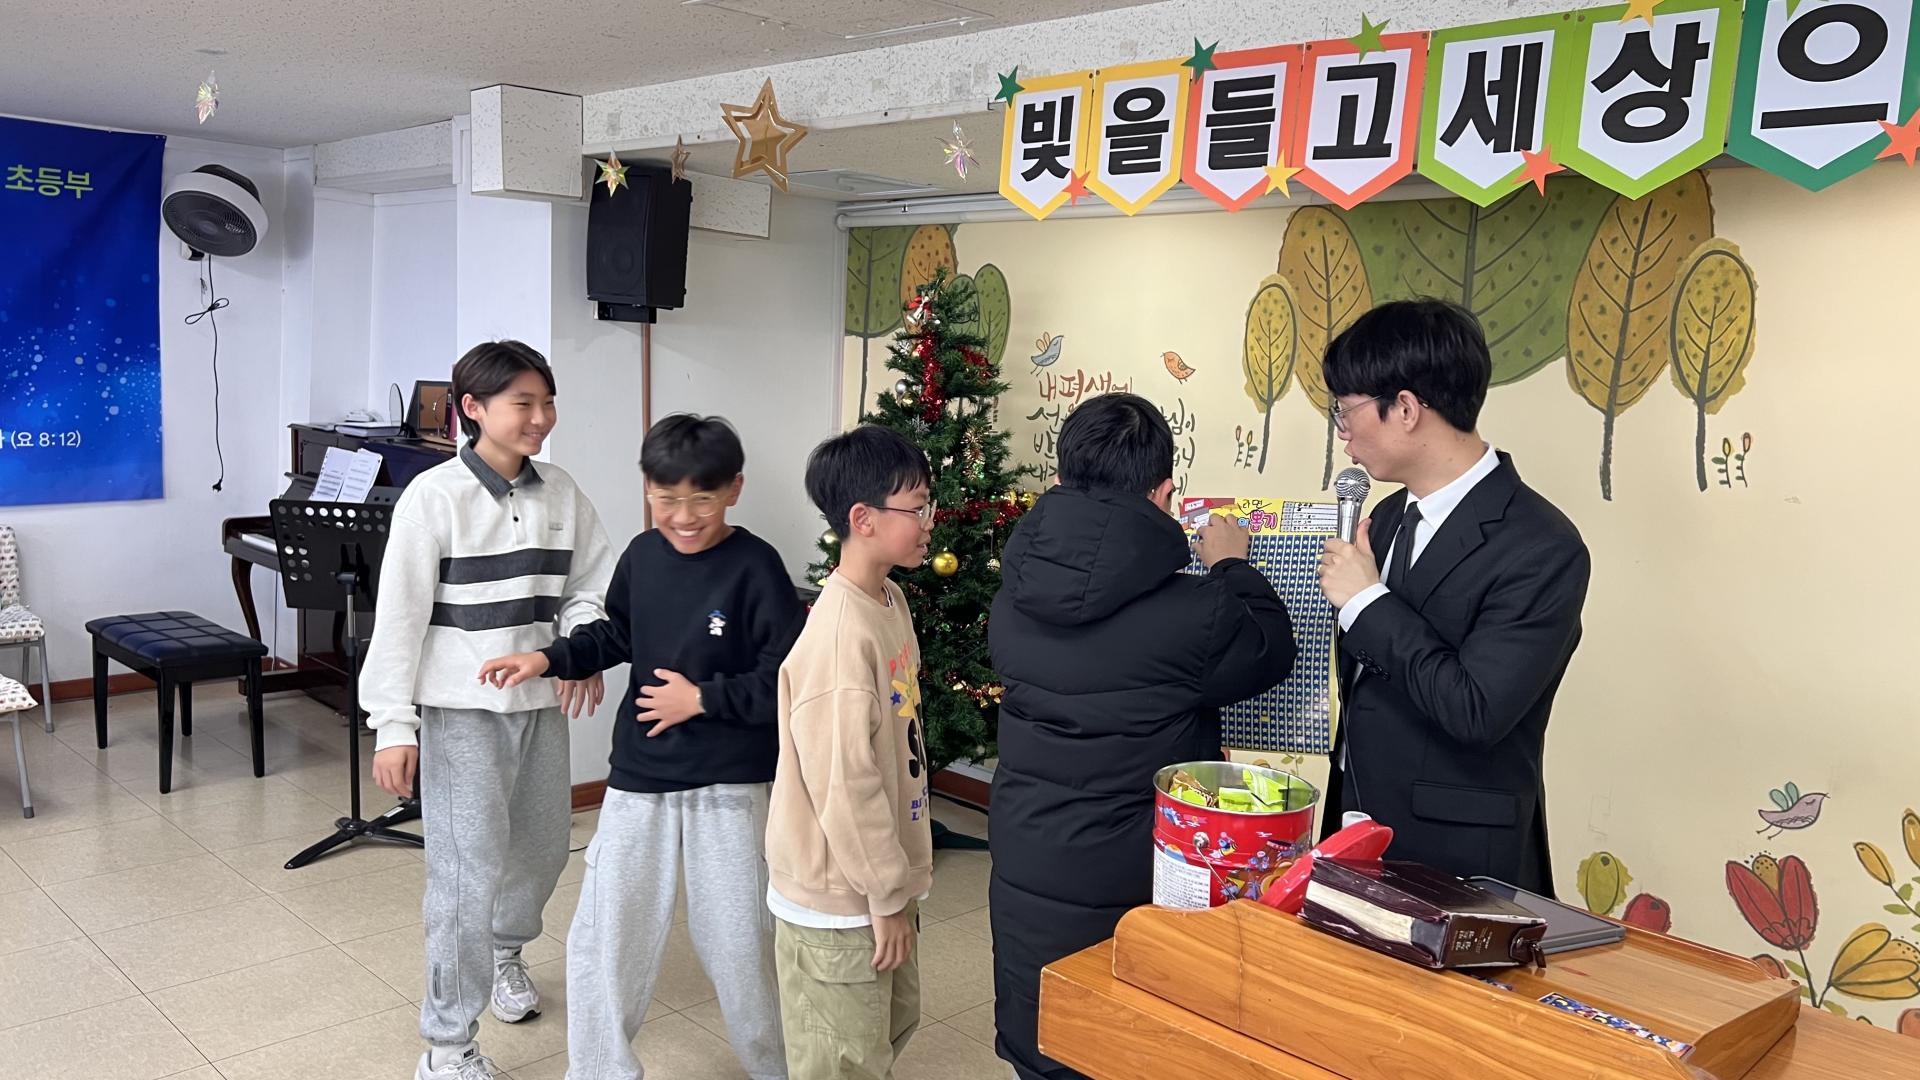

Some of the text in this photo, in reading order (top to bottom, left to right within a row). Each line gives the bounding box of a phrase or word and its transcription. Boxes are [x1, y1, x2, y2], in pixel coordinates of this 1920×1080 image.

[5, 164, 93, 199] 초등부
[11, 430, 34, 449] (요
[39, 430, 81, 448] 8:12)
[1250, 510, 1278, 533] 뽑기
